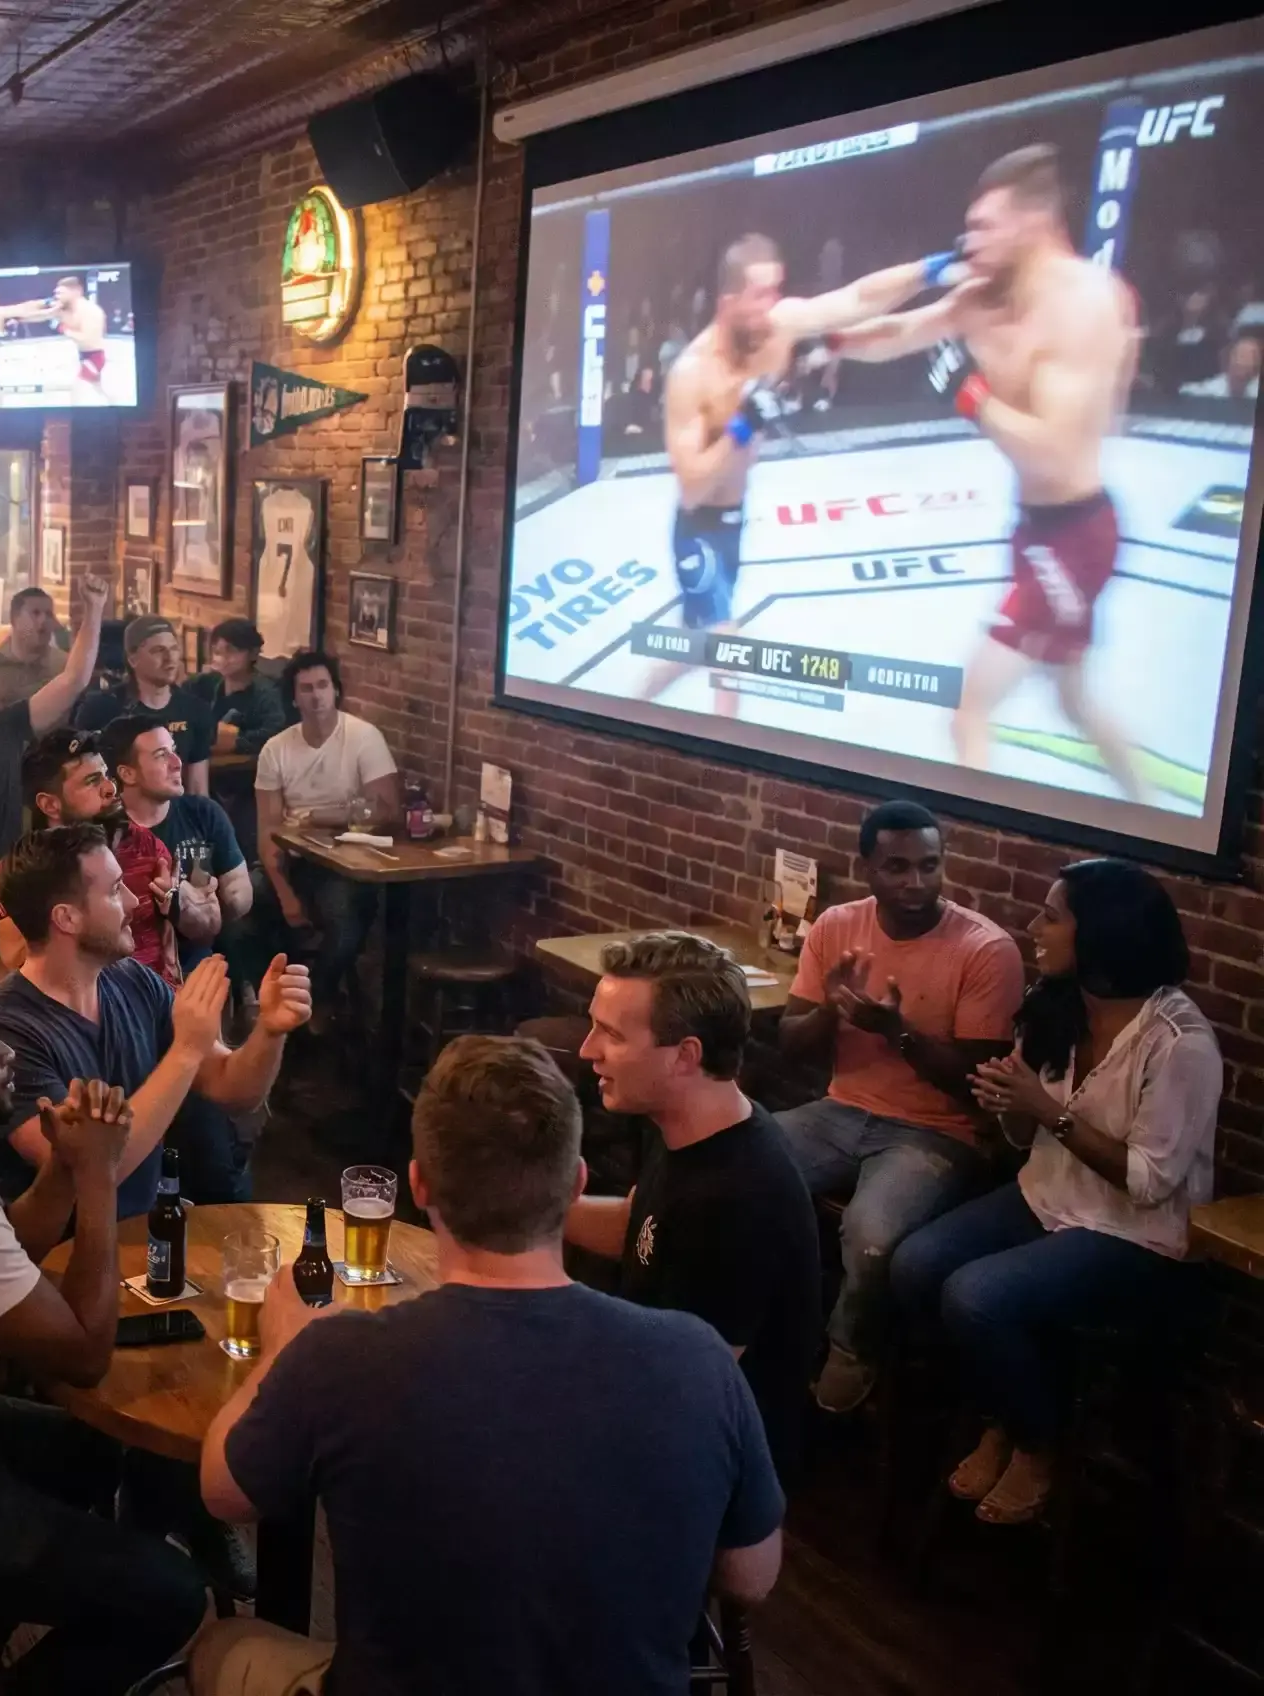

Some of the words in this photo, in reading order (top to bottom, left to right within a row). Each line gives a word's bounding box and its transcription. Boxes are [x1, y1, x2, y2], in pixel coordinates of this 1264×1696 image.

[1136, 95, 1226, 147] UFC
[776, 492, 908, 526] UFC
[276, 543, 293, 598] 7
[851, 553, 966, 582] UFC
[515, 559, 658, 650] TIRES
[715, 641, 753, 666] UFC
[760, 647, 793, 674] UFC
